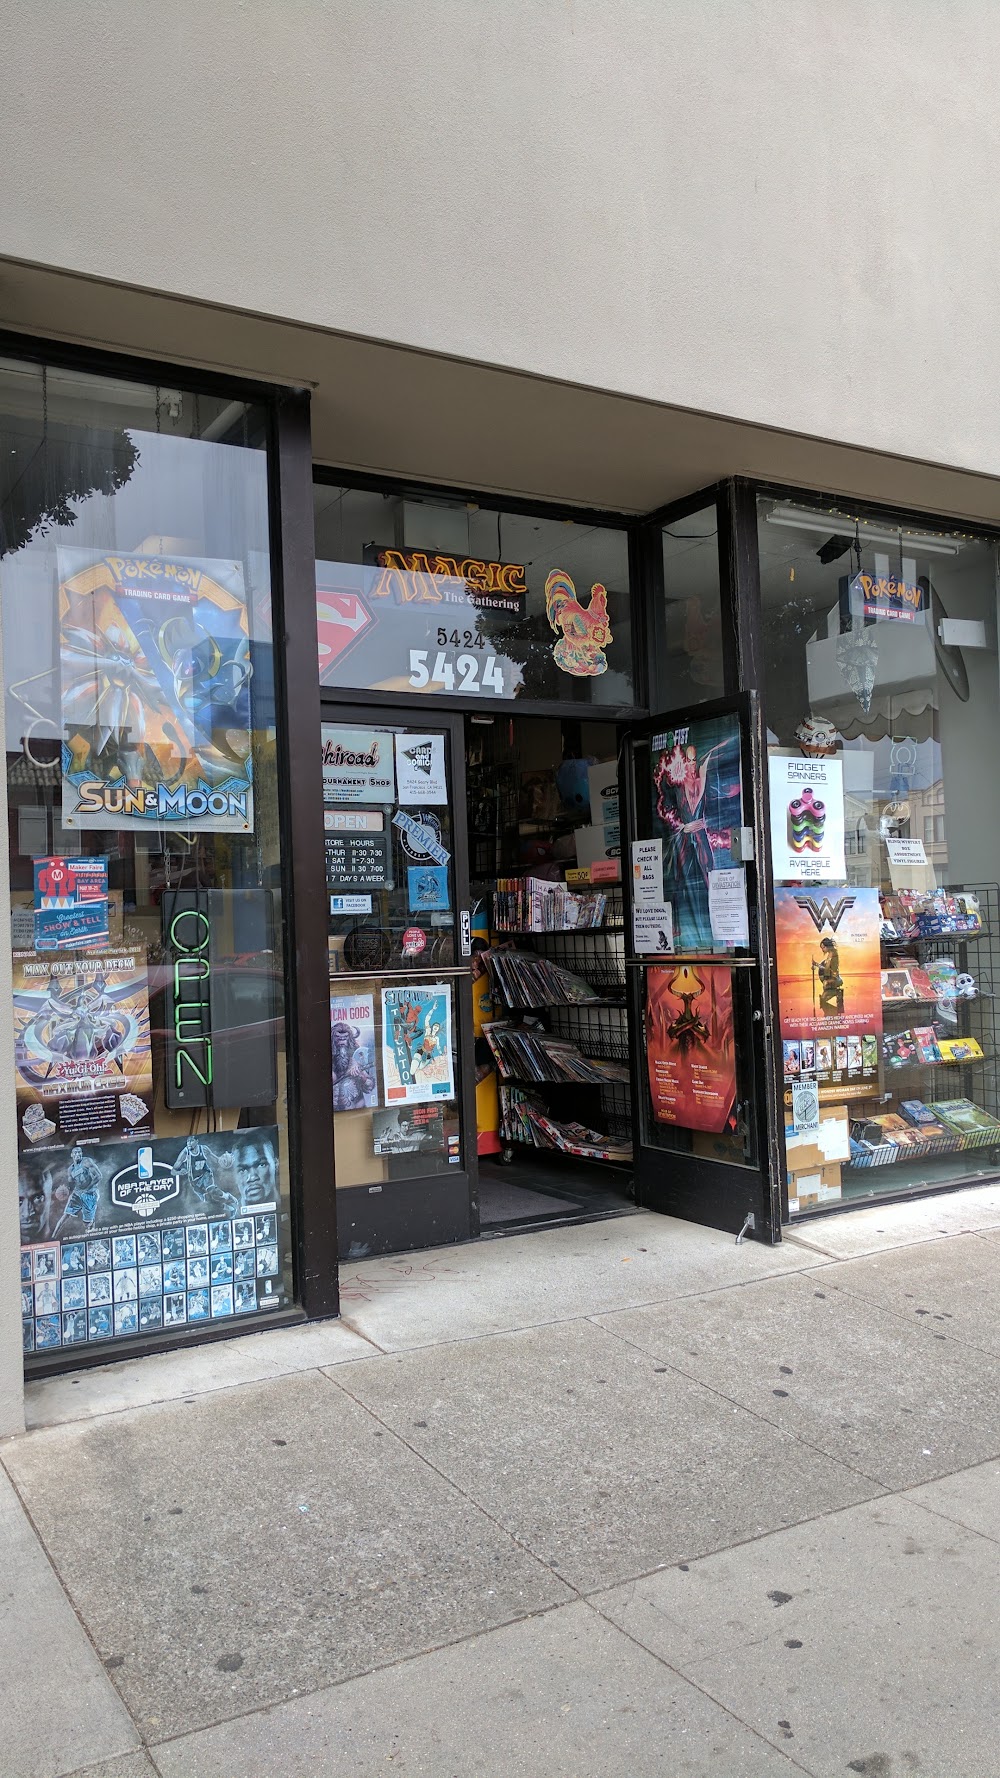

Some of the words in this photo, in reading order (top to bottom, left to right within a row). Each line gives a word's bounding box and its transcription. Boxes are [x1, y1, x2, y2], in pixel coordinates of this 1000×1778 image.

[376, 550, 528, 601] MAGIC
[124, 588, 152, 598] TRADING
[154, 592, 171, 601] CARD
[172, 595, 191, 603] GAME
[443, 591, 464, 604] The
[466, 594, 520, 612] Gathering
[868, 607, 886, 615] TRADING
[436, 627, 485, 650] 5424
[409, 649, 504, 694] 5424
[652, 733, 667, 751] IRON
[674, 727, 690, 746] FIST
[322, 740, 379, 768] hiroad
[787, 762, 826, 772] FIDGET
[369, 778, 391, 786] SHOP
[787, 771, 827, 781] SPINNERS
[394, 813, 448, 864] PREMIER
[789, 860, 831, 868] AVAILABLE
[53, 871, 62, 879] M
[800, 868, 821, 876] HERE
[43, 921, 70, 933] SHOW
[73, 919, 79, 927] &
[80, 916, 101, 925] TELL
[23, 963, 50, 978] MAX
[51, 962, 74, 975] OUT
[75, 959, 104, 974] YOUR
[104, 957, 135, 972] DECK!
[171, 911, 212, 1088] OPEN
[350, 1006, 370, 1020] GODS
[42, 1080, 92, 1096] MAXIMUM
[94, 1076, 126, 1089] CRISIS
[793, 1083, 816, 1091] MEMBER
[795, 1122, 819, 1130] MERCHANT
[118, 1183, 138, 1191] NBA
[138, 1178, 174, 1188] PLAYER
[120, 1189, 132, 1197] OF
[134, 1186, 152, 1195] THE
